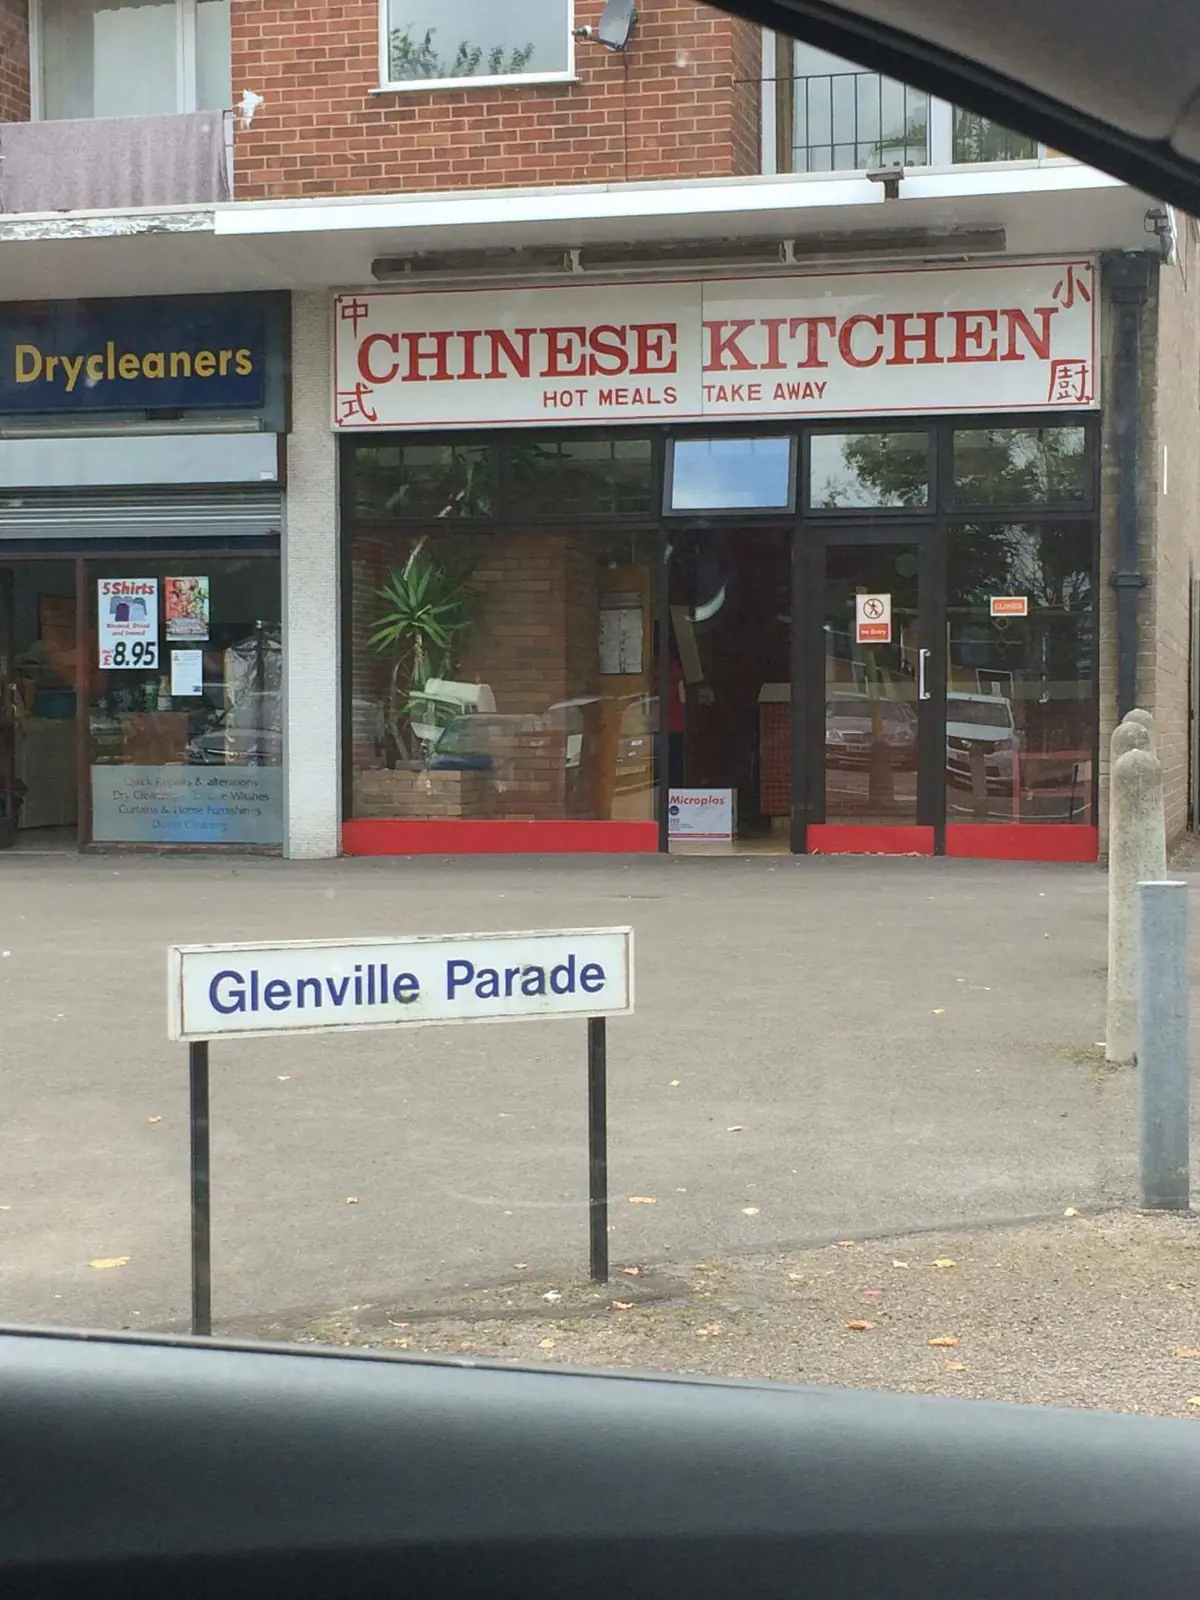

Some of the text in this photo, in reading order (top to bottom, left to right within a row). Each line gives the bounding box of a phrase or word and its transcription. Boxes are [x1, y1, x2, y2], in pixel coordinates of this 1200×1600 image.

[1052, 266, 1091, 309] 小
[341, 298, 369, 340] 中
[14, 341, 254, 392] Drycleaners
[357, 307, 1059, 384] CHINESE KITCHEN
[337, 382, 378, 422] 式
[543, 381, 828, 408] HOT MEALS TAKE AWAY
[125, 776, 153, 788] Quick
[669, 794, 725, 807] Microplas
[208, 954, 607, 1015] Glenville Parade
